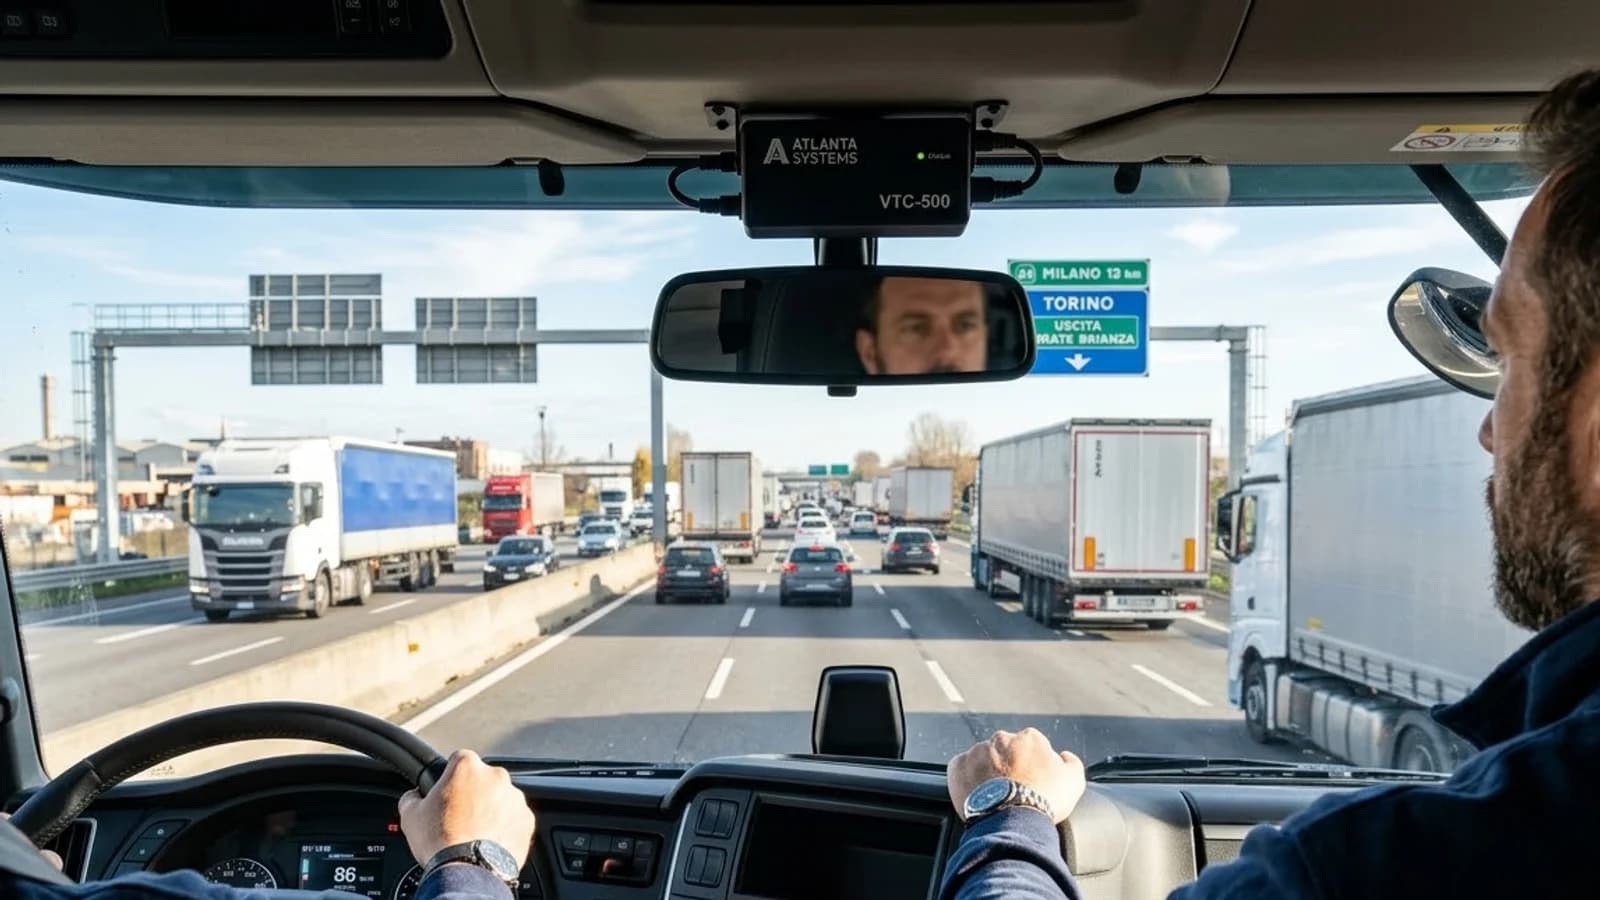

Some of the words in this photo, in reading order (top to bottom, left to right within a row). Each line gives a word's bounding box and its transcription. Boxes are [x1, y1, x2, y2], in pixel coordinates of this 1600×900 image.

[792, 138, 858, 150] ATLANTA
[792, 152, 859, 165] SYSTEMS
[879, 194, 951, 209] VTC-500
[1042, 267, 1102, 280] MILANO
[1043, 296, 1114, 311] TORINO
[1054, 320, 1101, 331] USCITA
[1078, 333, 1136, 345] BRIANZA
[333, 866, 357, 883] 86
